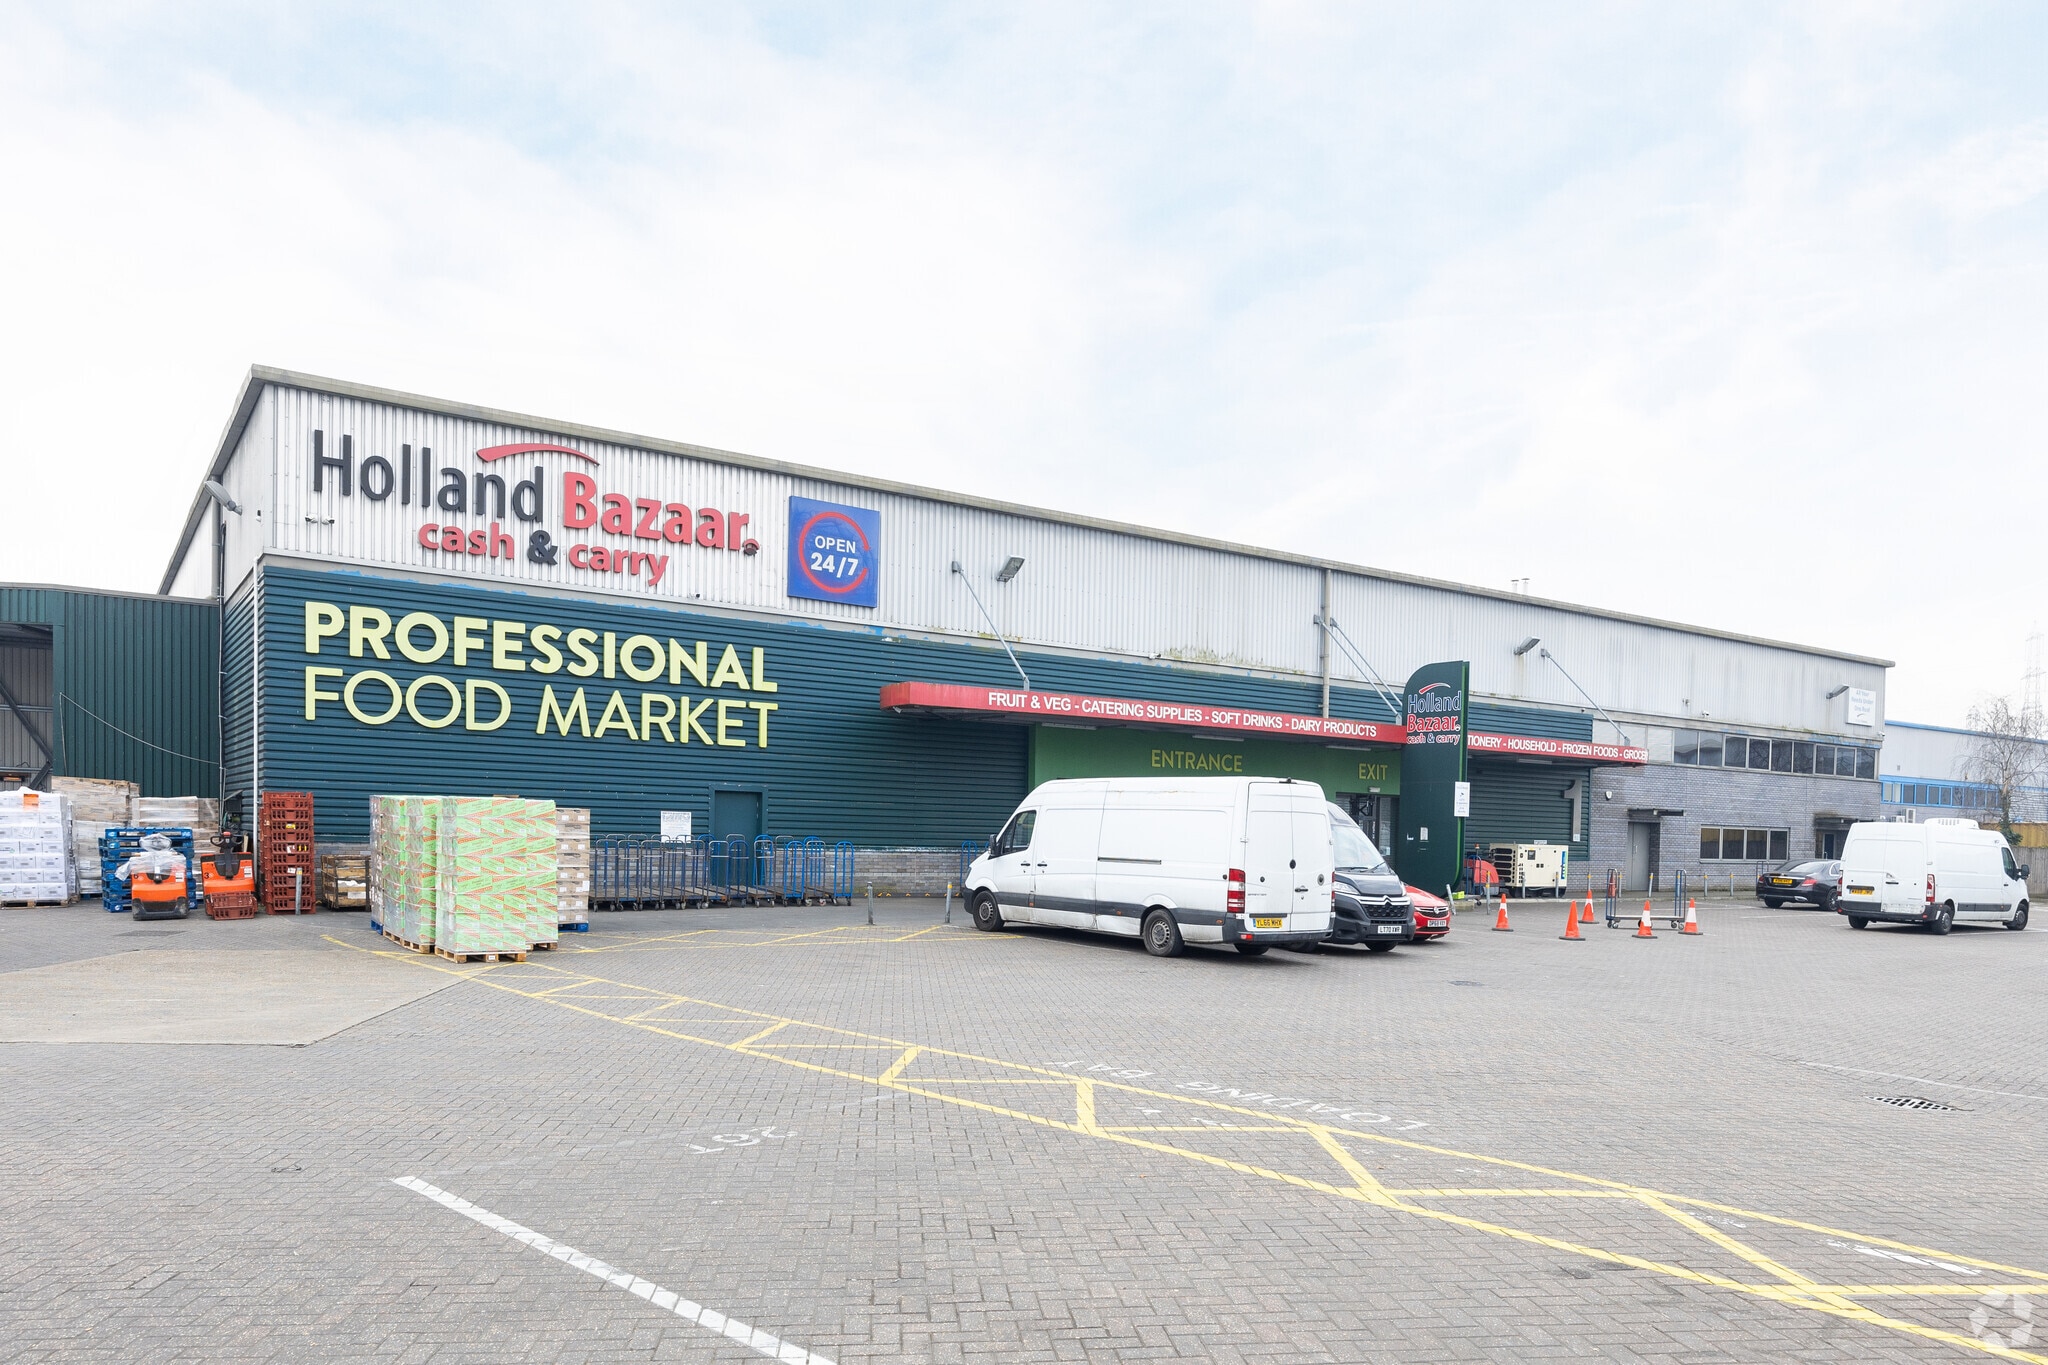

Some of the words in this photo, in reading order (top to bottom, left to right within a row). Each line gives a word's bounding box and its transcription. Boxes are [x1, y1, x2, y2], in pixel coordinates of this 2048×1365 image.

[314, 429, 543, 523] Holland
[418, 522, 514, 560] cash
[527, 530, 558, 566] &
[569, 544, 669, 586] carry
[814, 535, 856, 554] OPEN
[810, 552, 859, 578] 24/7
[304, 600, 778, 693] PROFESSIONAL
[305, 666, 512, 731] FOOD
[536, 684, 779, 749] MARKET
[988, 692, 1027, 708] FRUIT
[1030, 695, 1041, 709] &
[1043, 696, 1071, 711] VEG
[1082, 699, 1144, 717] CATERING
[1146, 705, 1202, 722] SUPPLIES
[1211, 711, 1241, 725] SOFT
[1243, 714, 1283, 729] DRINKS
[1291, 718, 1321, 732] DAIRY
[1323, 721, 1377, 737] PRODUCTS
[1407, 690, 1462, 713] Holland
[1406, 733, 1426, 744] cash
[1427, 733, 1435, 743] &
[1436, 734, 1461, 746] carry
[1507, 738, 1557, 752] HOUSEHOLD
[1562, 743, 1592, 755] FROZEN
[1593, 745, 1618, 758] FOODS
[1151, 749, 1243, 773] ENTRANCE
[1358, 762, 1388, 780] EXIT
[1176, 1081, 1431, 1131] LOADING
